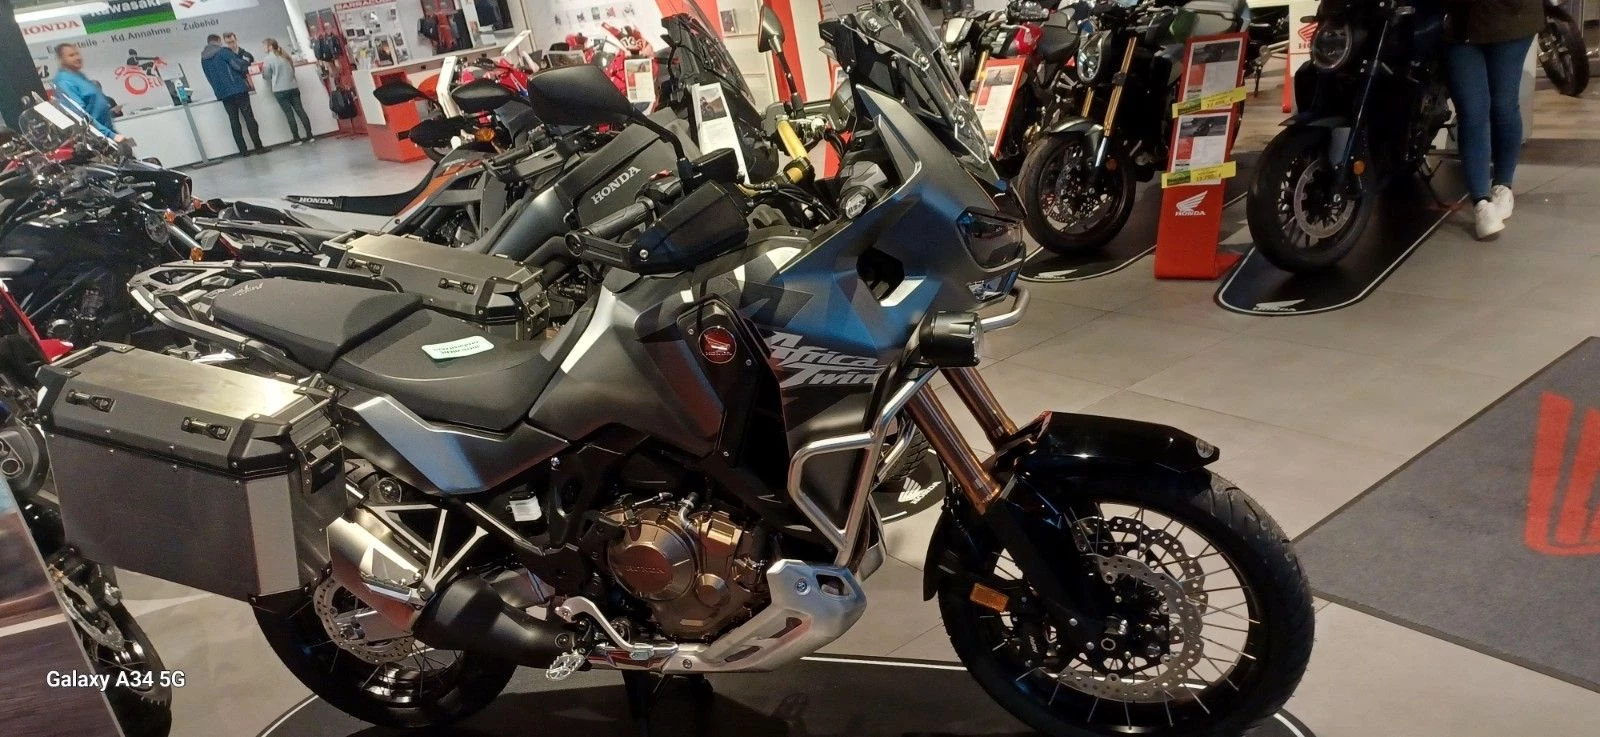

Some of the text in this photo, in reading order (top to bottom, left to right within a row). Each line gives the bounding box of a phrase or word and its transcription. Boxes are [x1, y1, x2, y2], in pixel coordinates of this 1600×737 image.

[299, 197, 334, 205] HONDA
[591, 166, 641, 205] HONDA
[763, 331, 879, 367] Africa
[780, 361, 882, 388] Twin
